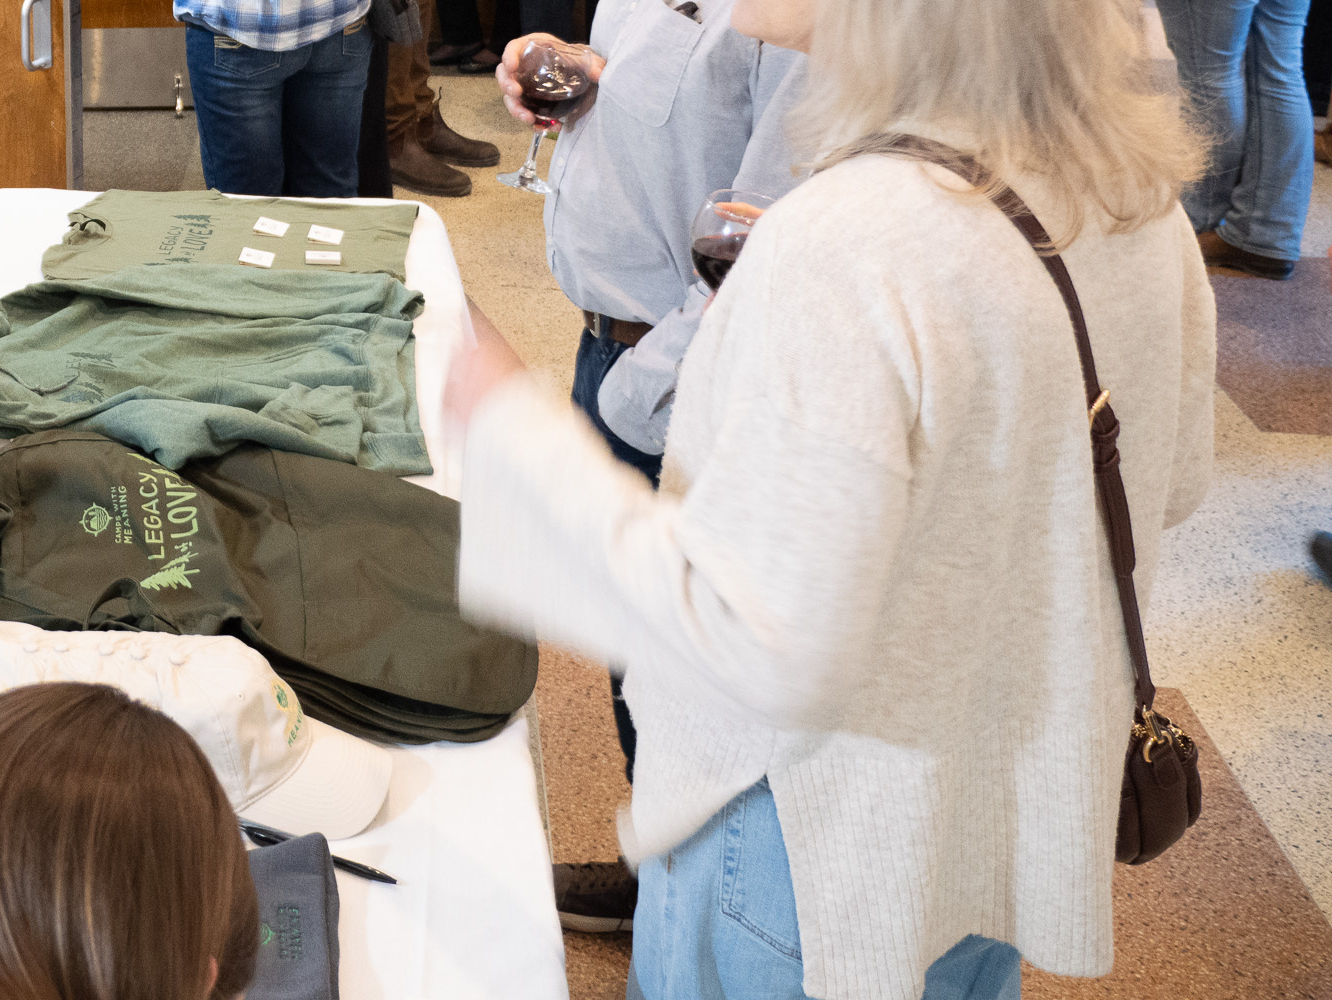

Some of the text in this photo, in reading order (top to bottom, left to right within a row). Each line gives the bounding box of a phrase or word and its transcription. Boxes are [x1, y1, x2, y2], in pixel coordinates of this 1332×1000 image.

[157, 226, 184, 256] LEGACY
[181, 228, 213, 251] LOVE
[118, 485, 133, 544] MEANING
[138, 472, 165, 560] LEGACY
